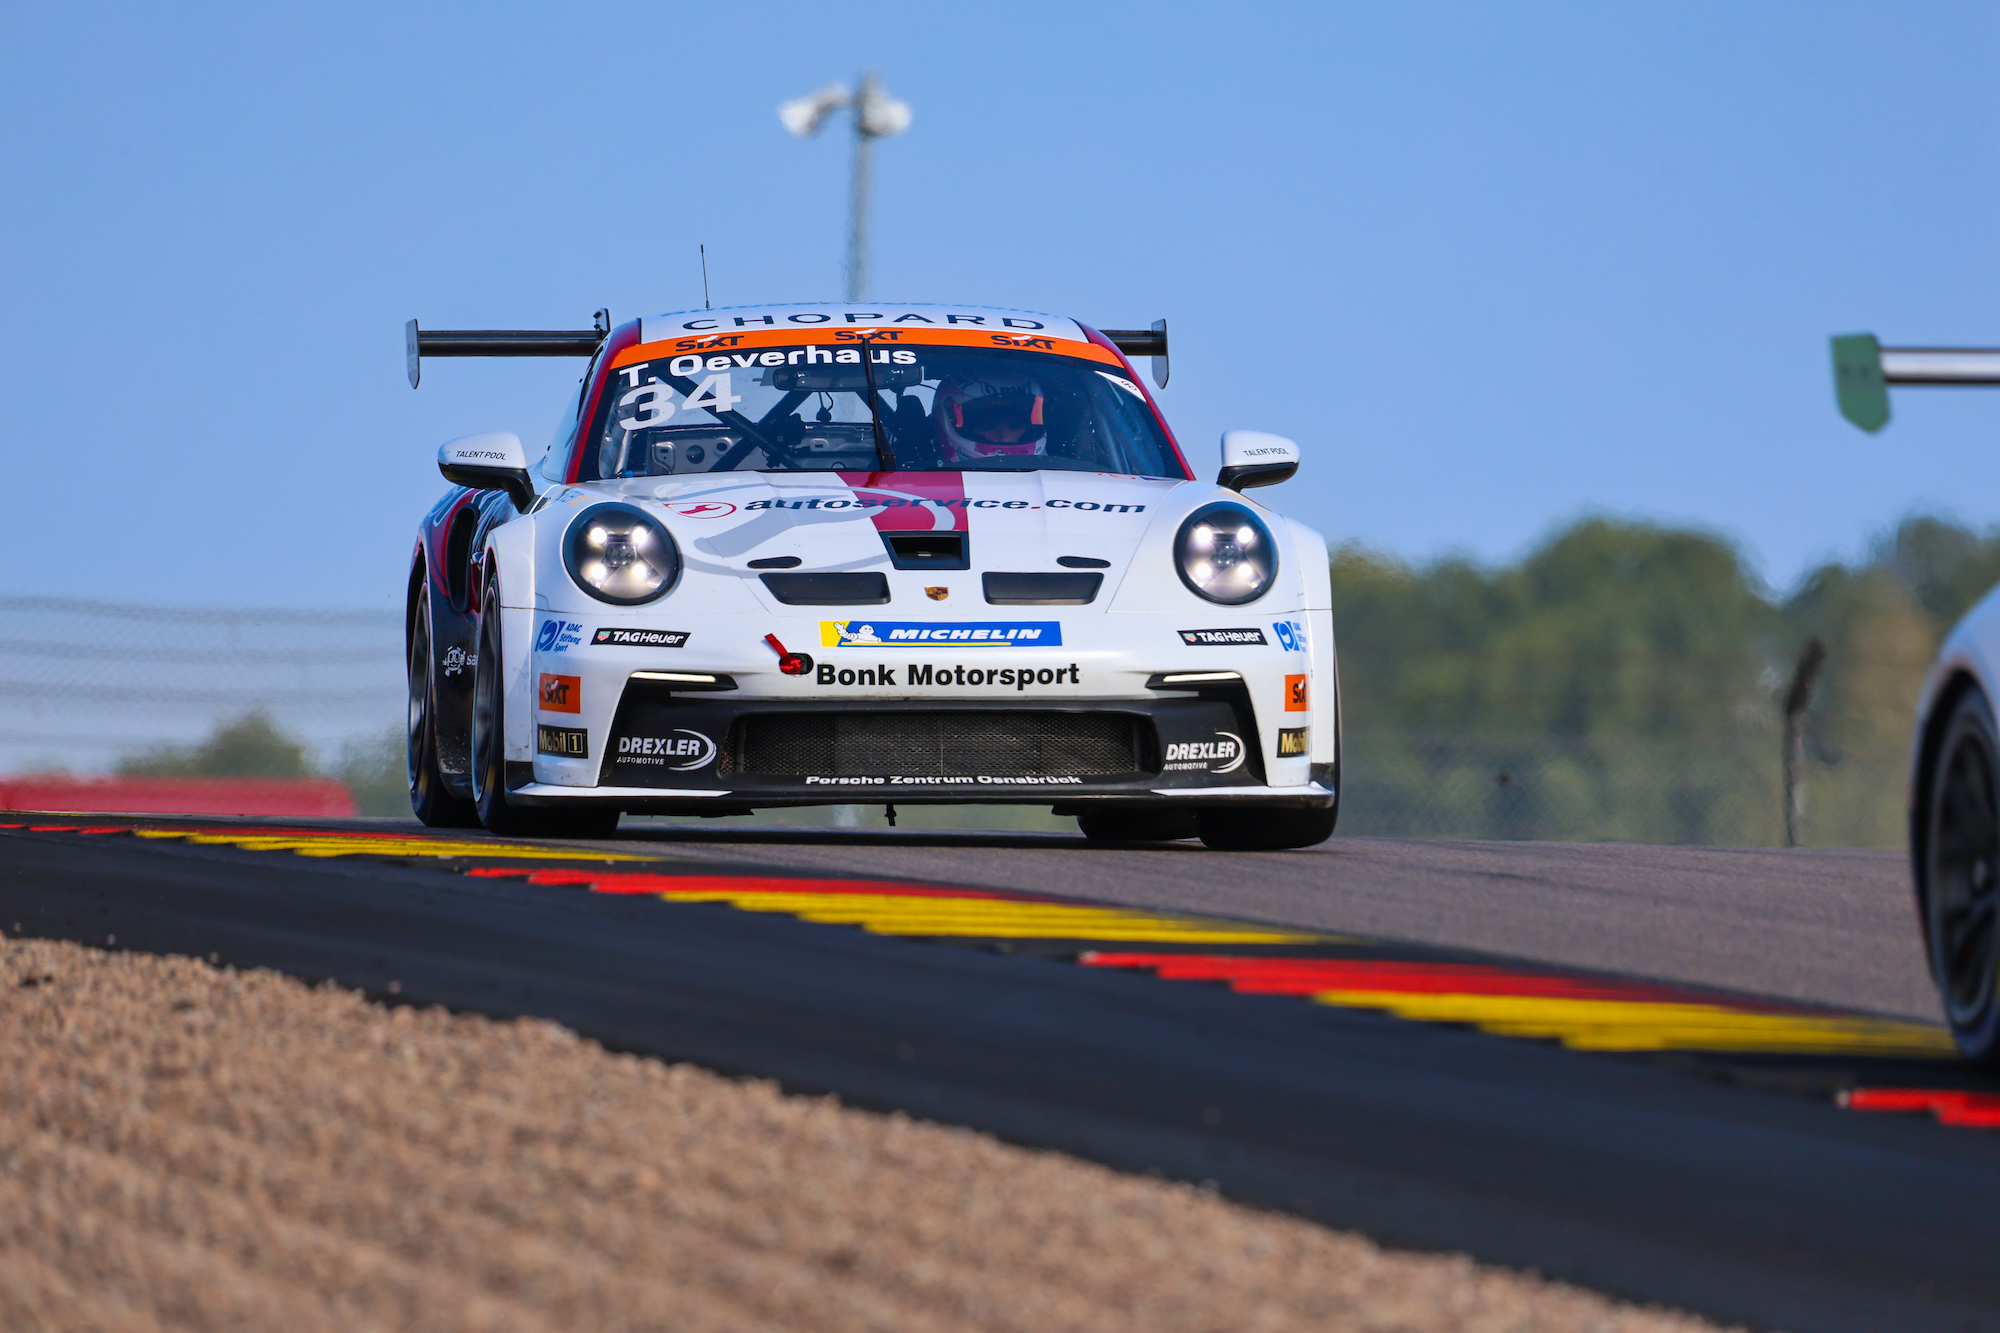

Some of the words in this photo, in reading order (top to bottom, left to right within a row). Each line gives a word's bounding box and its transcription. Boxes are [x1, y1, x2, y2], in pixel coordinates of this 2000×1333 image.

[682, 313, 1045, 330] CHOPARD
[618, 363, 657, 388] T.
[669, 344, 917, 377] Oeverhaus
[618, 372, 742, 431] 34
[455, 450, 485, 459] TALENT
[485, 451, 507, 461] POOL
[1242, 448, 1271, 457] TALENT
[1270, 447, 1290, 456] POOL
[744, 498, 1147, 514] autoservice.com
[565, 622, 583, 632] ADAC
[559, 633, 582, 645] Stiftung
[889, 629, 1042, 640] MICHELIN
[554, 643, 569, 653] Sport
[816, 663, 897, 686] Bonk
[907, 663, 1080, 691] Motorsport
[539, 729, 567, 752] Mobil
[618, 736, 701, 757] DREXLER
[1165, 741, 1236, 761] DREXLER
[616, 756, 665, 766] AUTOMOTIVE
[1163, 761, 1208, 771] AUTOMOTIVE
[805, 775, 885, 785] Porsche
[889, 775, 974, 785] Zentrum
[976, 774, 1083, 785] Osnabrück
